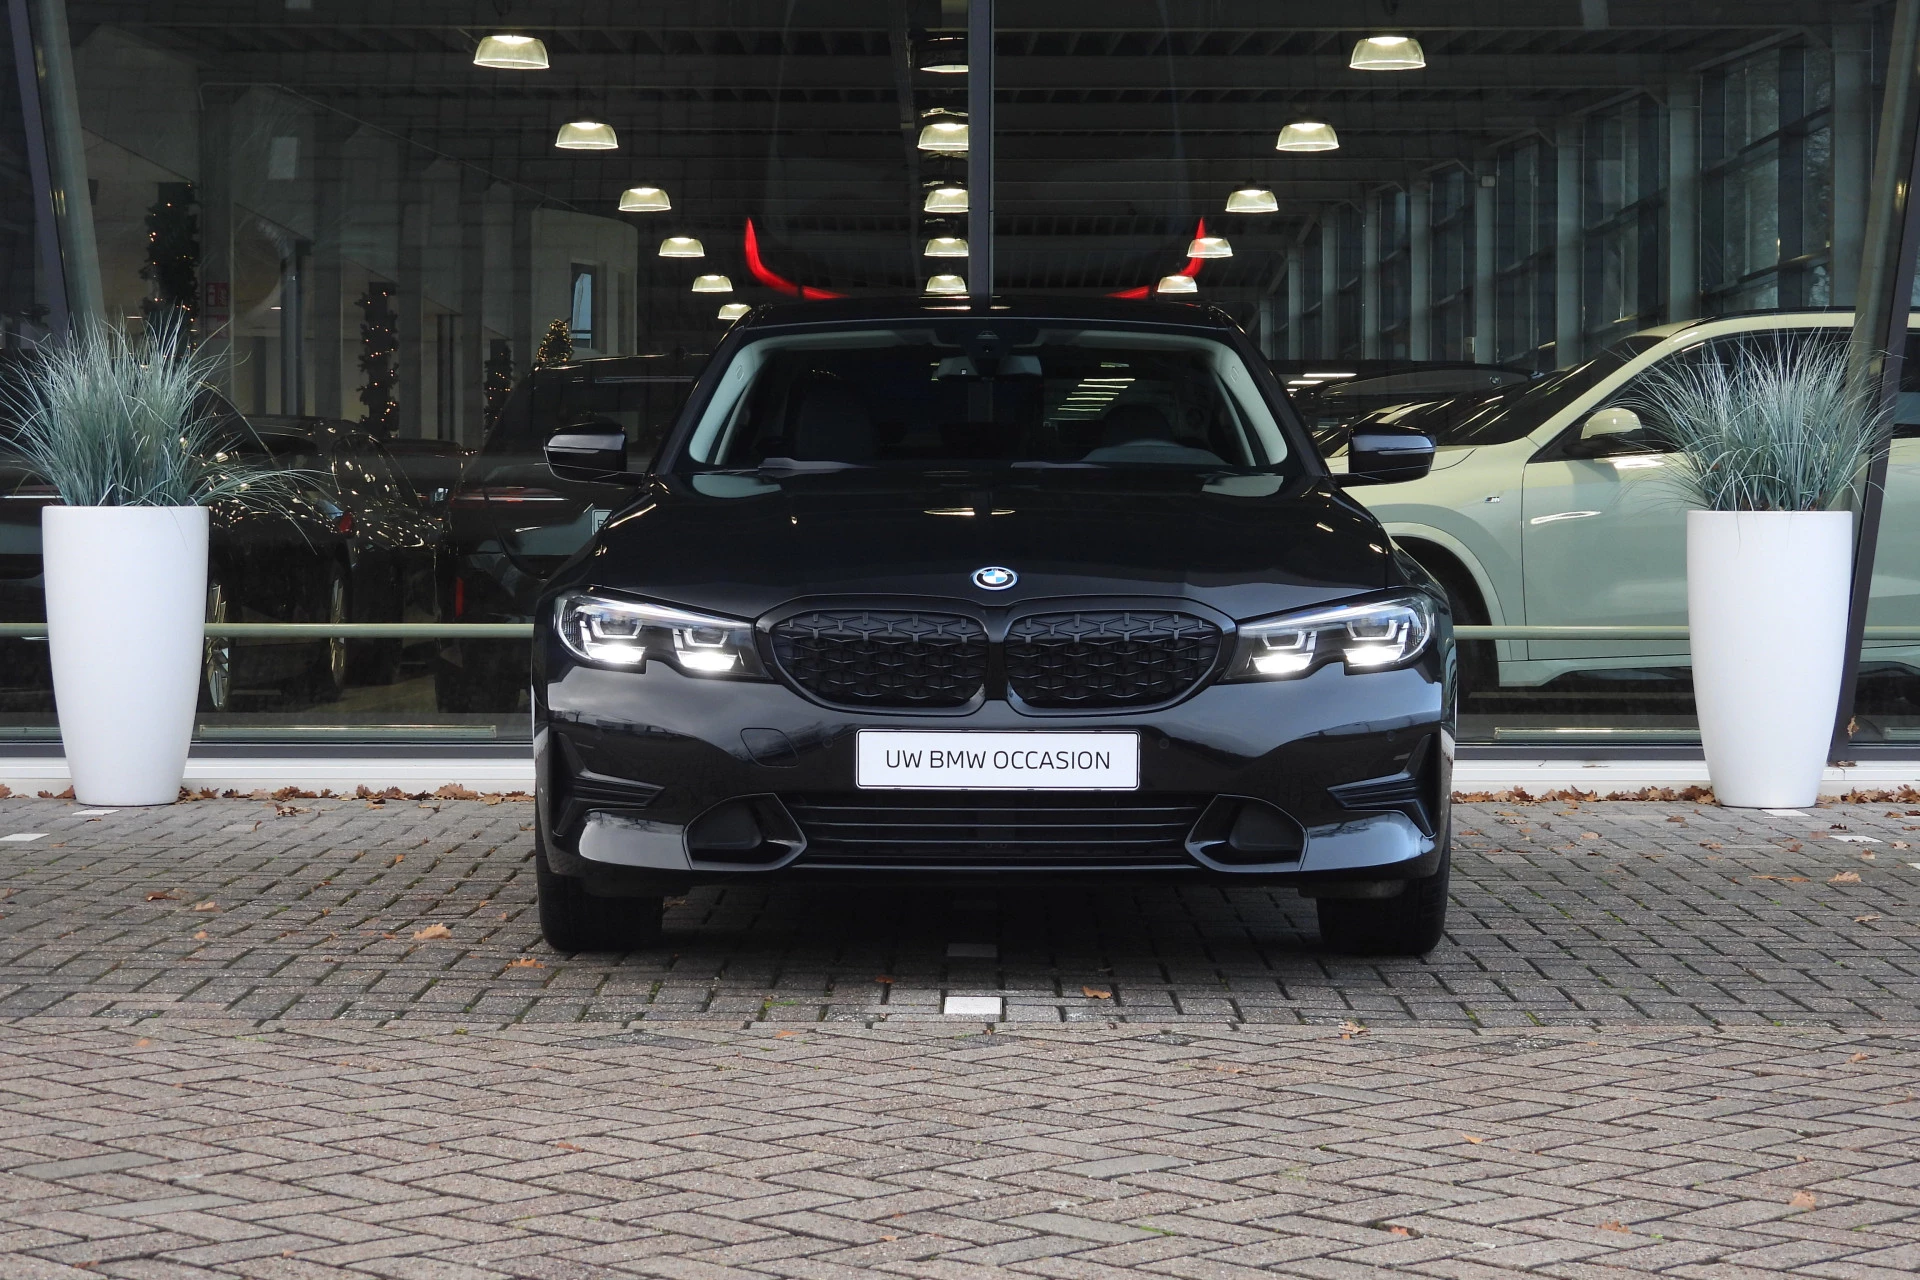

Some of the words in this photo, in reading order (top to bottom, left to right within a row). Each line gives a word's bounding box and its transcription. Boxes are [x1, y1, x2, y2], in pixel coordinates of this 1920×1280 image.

[886, 749, 923, 769] UW
[930, 750, 987, 769] BMW
[993, 750, 1110, 770] OCCASION
